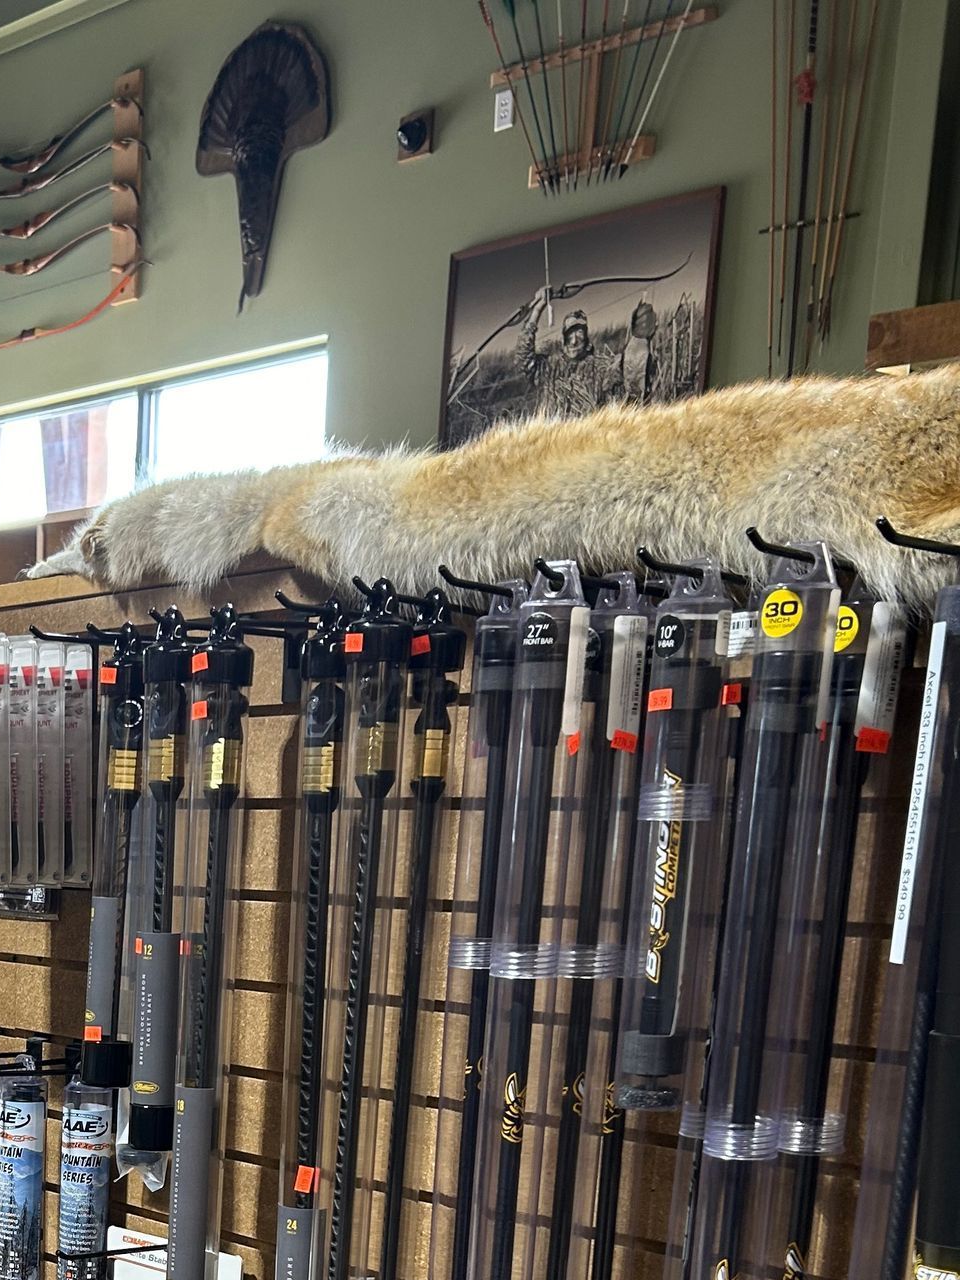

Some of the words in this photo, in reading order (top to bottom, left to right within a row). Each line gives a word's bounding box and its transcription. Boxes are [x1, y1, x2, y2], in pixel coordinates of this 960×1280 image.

[765, 600, 799, 618] 30
[527, 623, 550, 639] 27"
[836, 616, 854, 631] 0
[660, 625, 678, 640] 10"
[540, 637, 554, 645] BAR
[924, 670, 937, 707] Axcel
[922, 711, 932, 728] 33
[918, 731, 931, 759] inch
[143, 944, 153, 956] 12
[177, 1099, 185, 1111] 18
[64, 1118, 99, 1133] AAE
[62, 1170, 93, 1184] SERIES
[286, 1219, 297, 1231] 24
